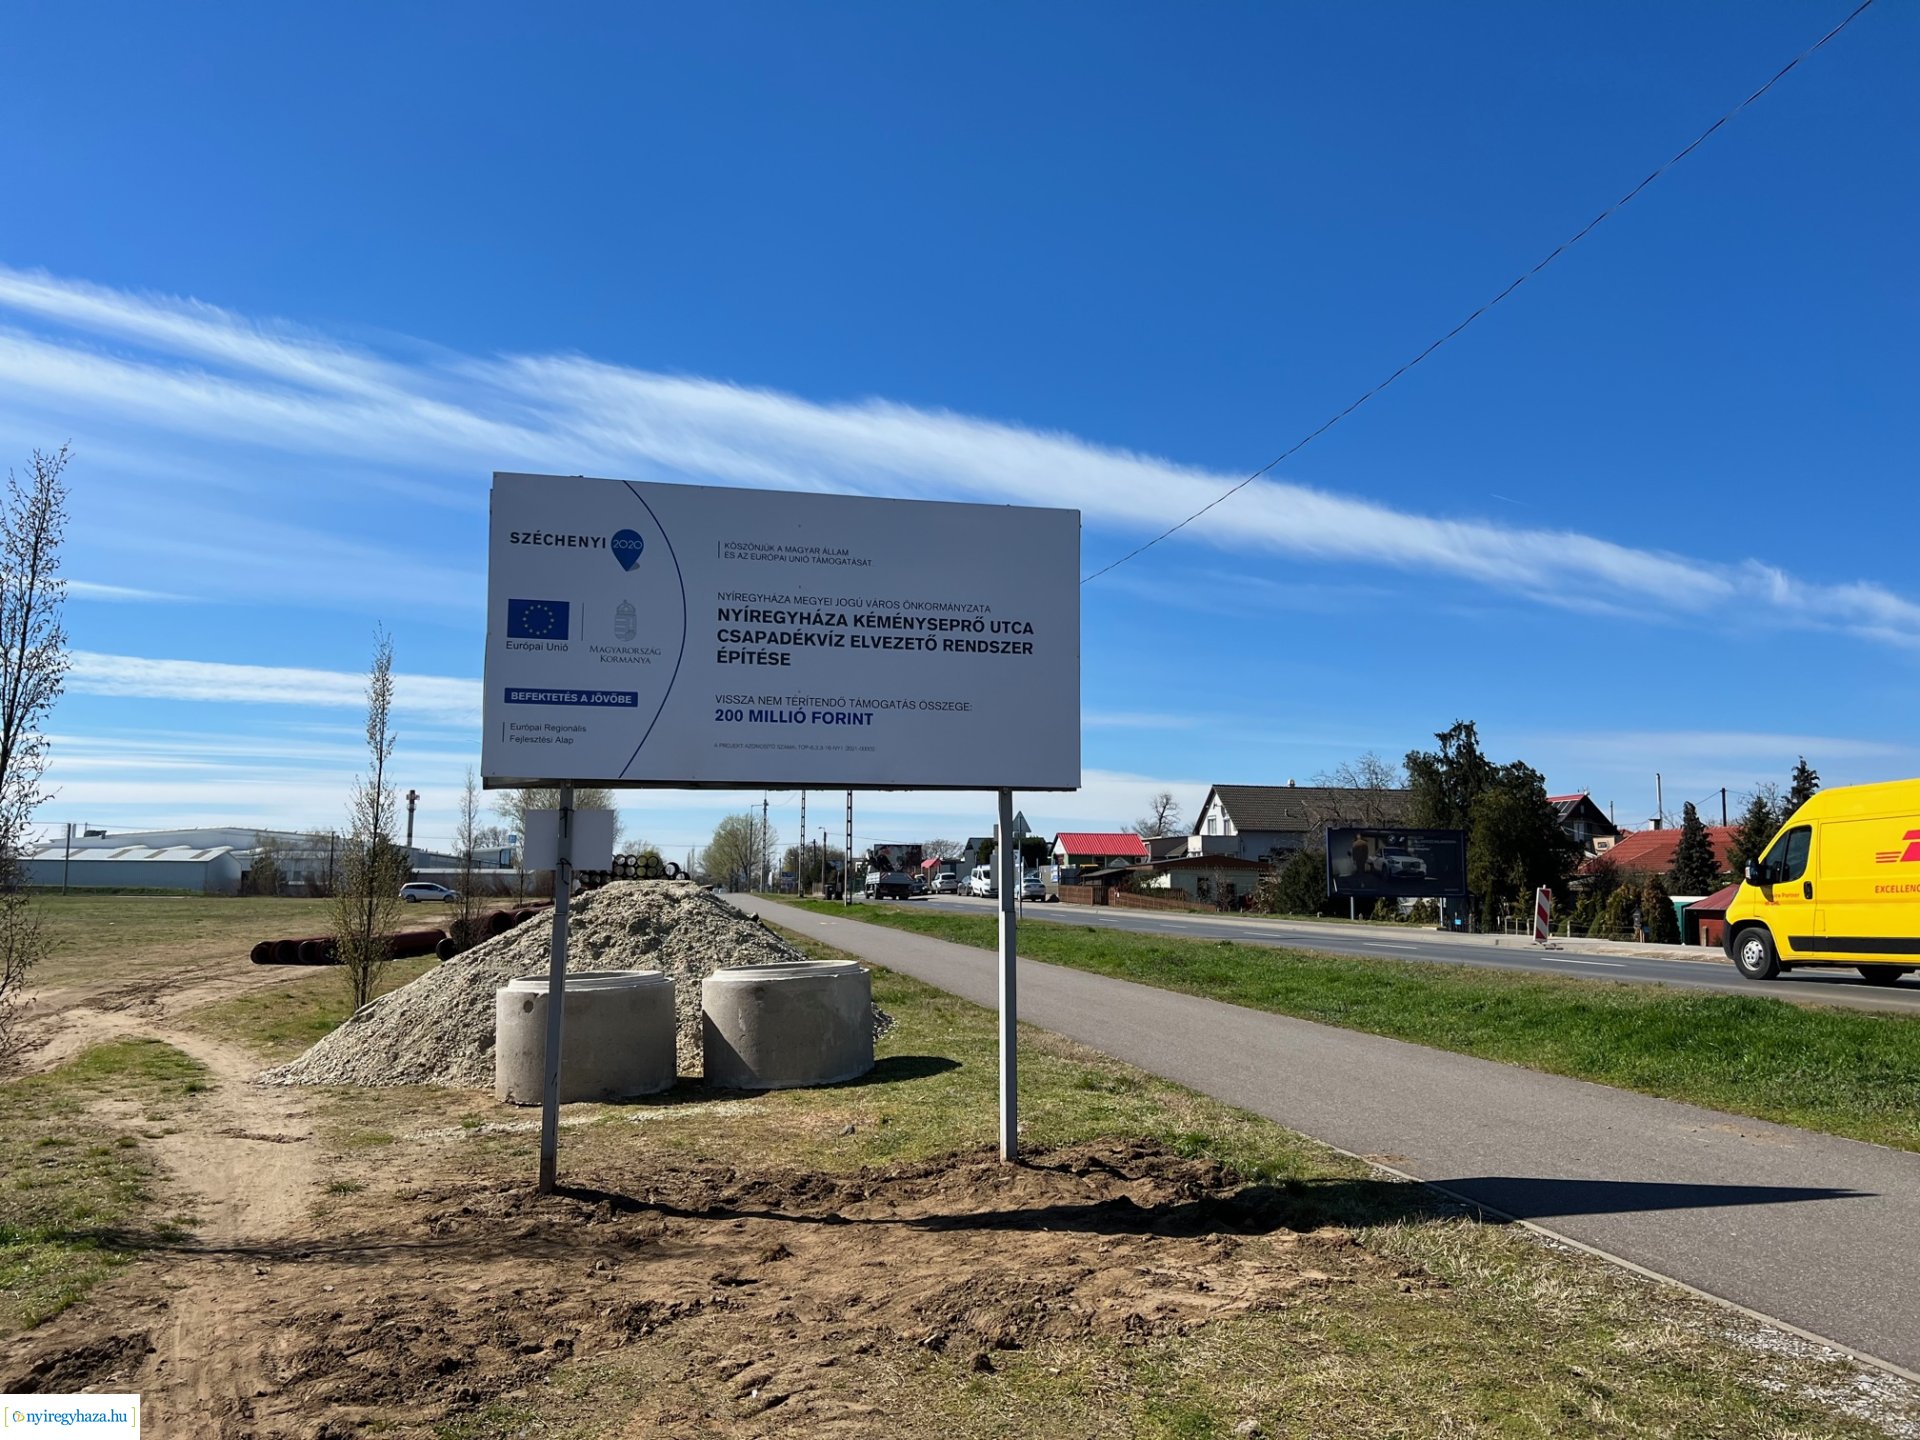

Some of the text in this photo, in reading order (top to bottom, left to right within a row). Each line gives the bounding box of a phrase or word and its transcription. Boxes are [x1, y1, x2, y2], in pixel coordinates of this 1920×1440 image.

[510, 530, 643, 550] SZÉCHENYI 2020
[724, 542, 776, 552] KÖSZÖNJÜK
[785, 546, 820, 555] MAGYAR
[822, 546, 849, 556] ÁLLAM
[724, 551, 735, 559] ÉS
[737, 552, 749, 560] AZ
[750, 552, 787, 562] EURÓPAI
[789, 554, 809, 564] UNIÓ
[718, 592, 991, 614] NYÍREGYHÁZA MEGYEI JOGÚ VÁROS ÖNKORMÁNYZATA
[717, 606, 1034, 635] NYÍREGYHÁZA KÉMÉNYSEPRŐ UTCA
[506, 641, 569, 652] Európai Unió
[717, 629, 1033, 655] CSAPADÉKVÍZ ELVEZETŐ RENDSZER
[589, 645, 662, 656] MAGYARORSZÁG
[716, 646, 791, 666] ÉPÍTÉSE
[600, 654, 652, 665] KORMÁNYA
[511, 689, 578, 702] BEFEKTETÉS
[590, 691, 632, 704] JÖVŐBE
[715, 694, 973, 712] VISSZA NEM TÉRÍTENDŐ TÁMOGATÁS ÖSSZEGE:
[715, 708, 874, 726] 200 MILLIÓ FORINT
[510, 722, 587, 734] Európai Regionális
[509, 735, 574, 745] Fejlesztési Alap
